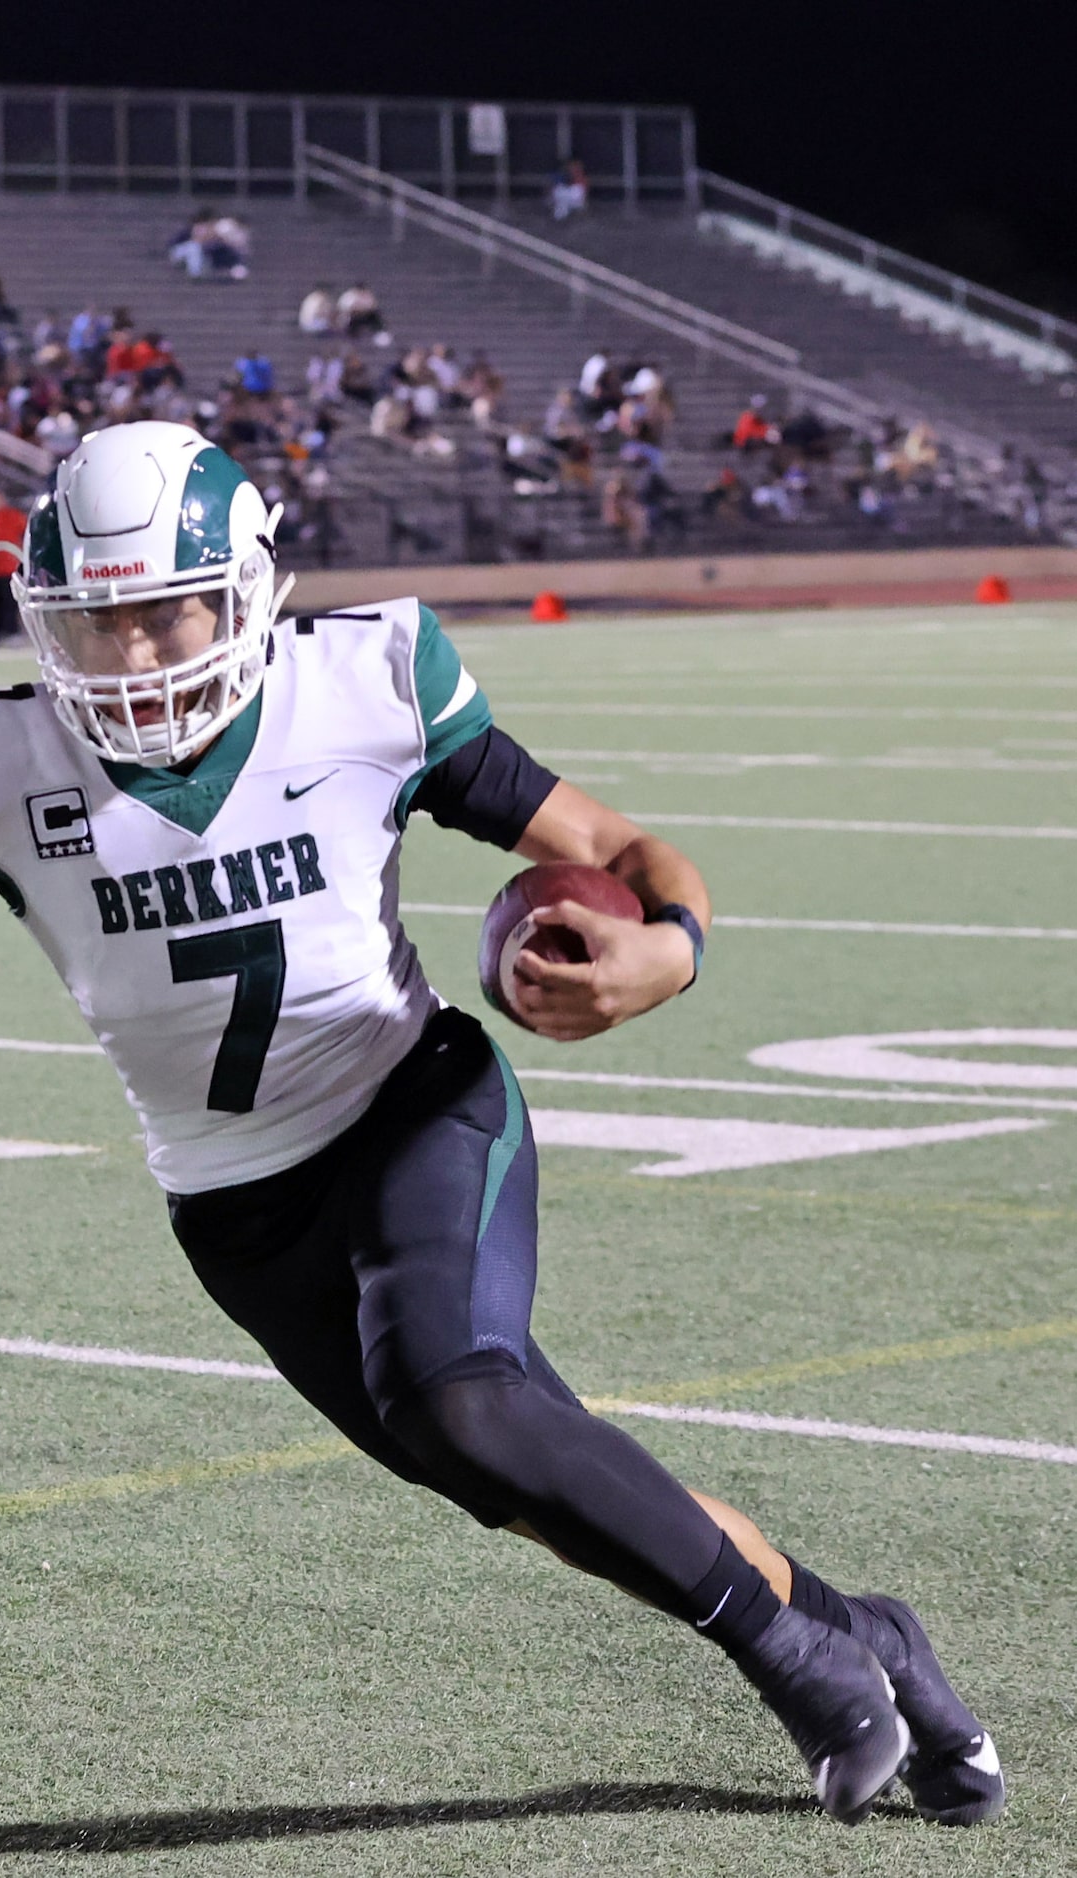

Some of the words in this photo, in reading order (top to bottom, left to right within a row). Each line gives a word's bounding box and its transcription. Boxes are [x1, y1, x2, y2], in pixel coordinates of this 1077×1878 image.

[82, 560, 145, 579] Riddell
[28, 789, 89, 845] C
[91, 832, 327, 934] BERKNER
[167, 918, 287, 1114] 7
